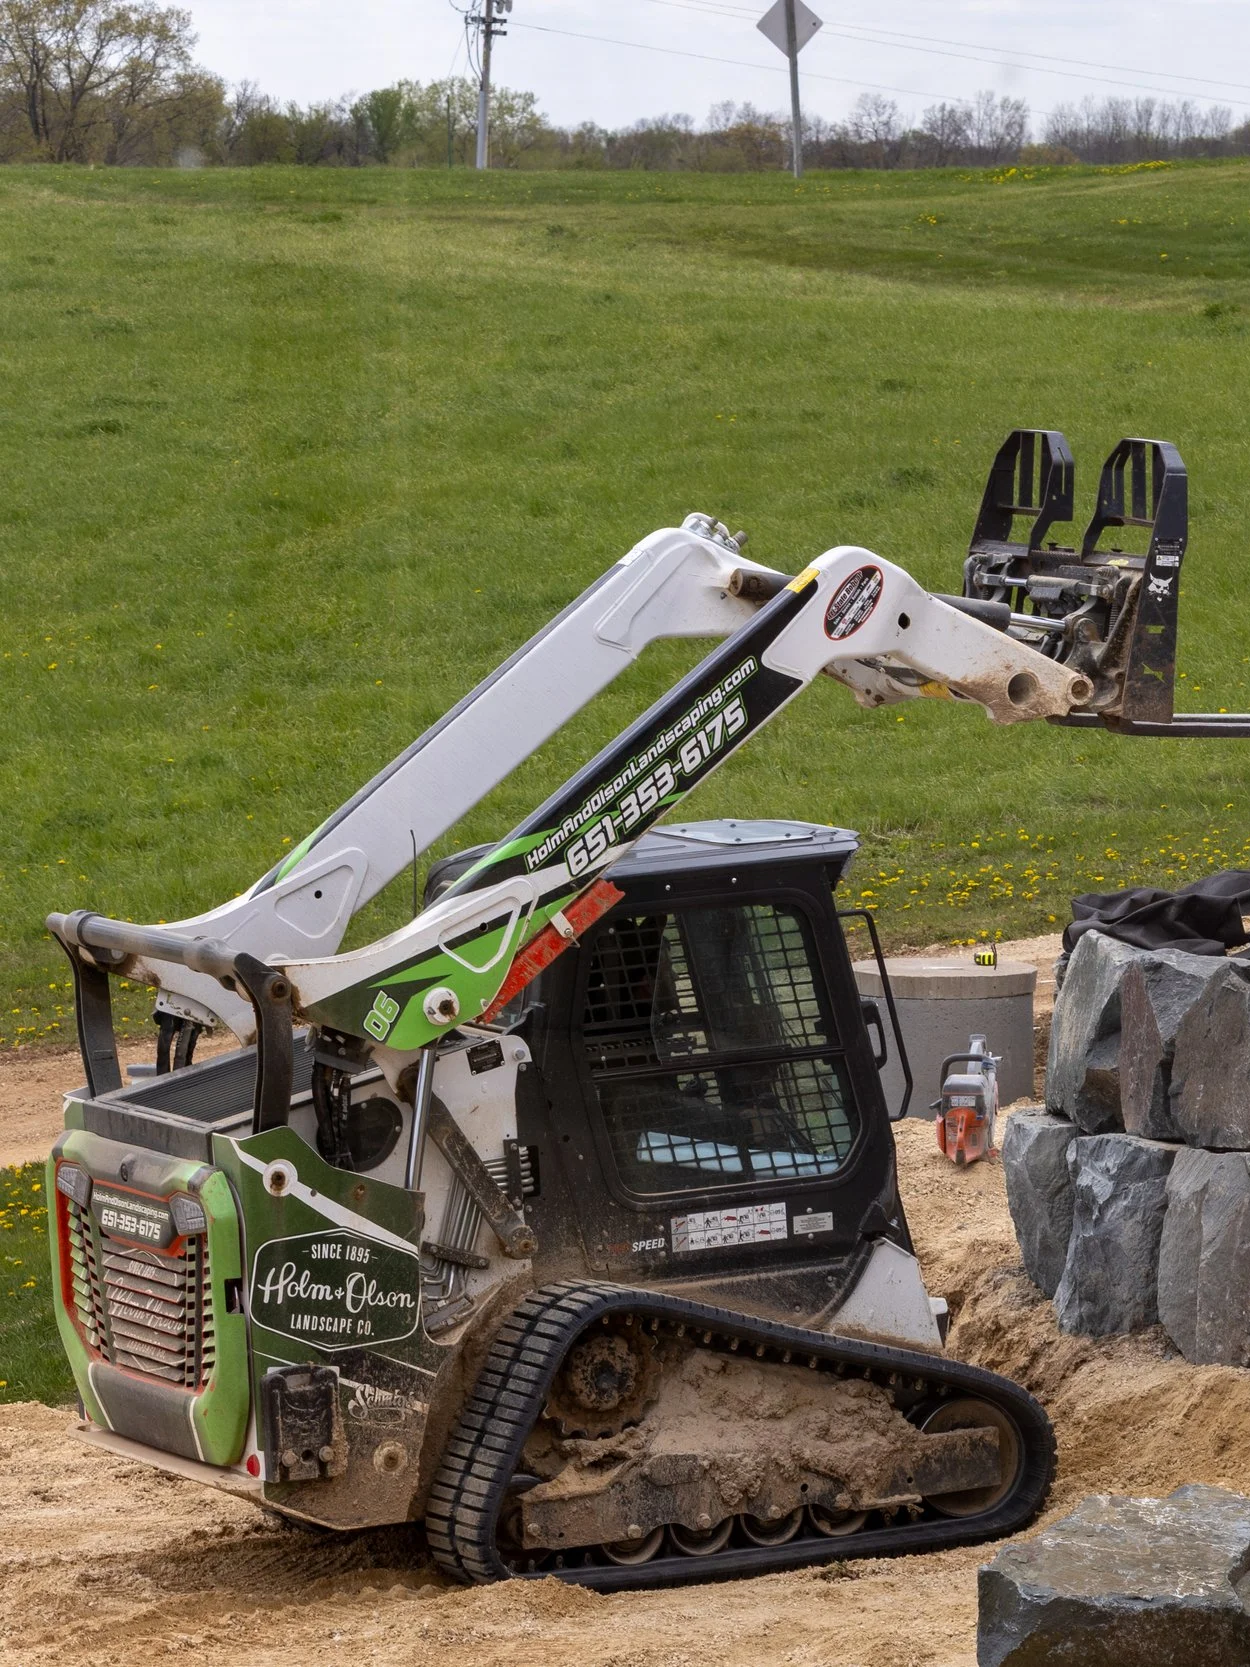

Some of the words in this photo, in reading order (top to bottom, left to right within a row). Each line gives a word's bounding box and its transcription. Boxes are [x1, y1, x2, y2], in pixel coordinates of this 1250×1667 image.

[526, 657, 757, 870] HolmAndOlsonLandscaping.com
[566, 696, 746, 877] 651-353-6175
[363, 989, 400, 1041] 06
[102, 1208, 161, 1240] 651-353-6175
[311, 1243, 342, 1260] SINCE
[345, 1245, 371, 1264] 1895
[632, 1238, 665, 1253] SPEED
[257, 1262, 334, 1305] Holm
[346, 1271, 416, 1314] Olson
[290, 1313, 353, 1334] LANDSCAPE
[357, 1319, 375, 1336] CO.
